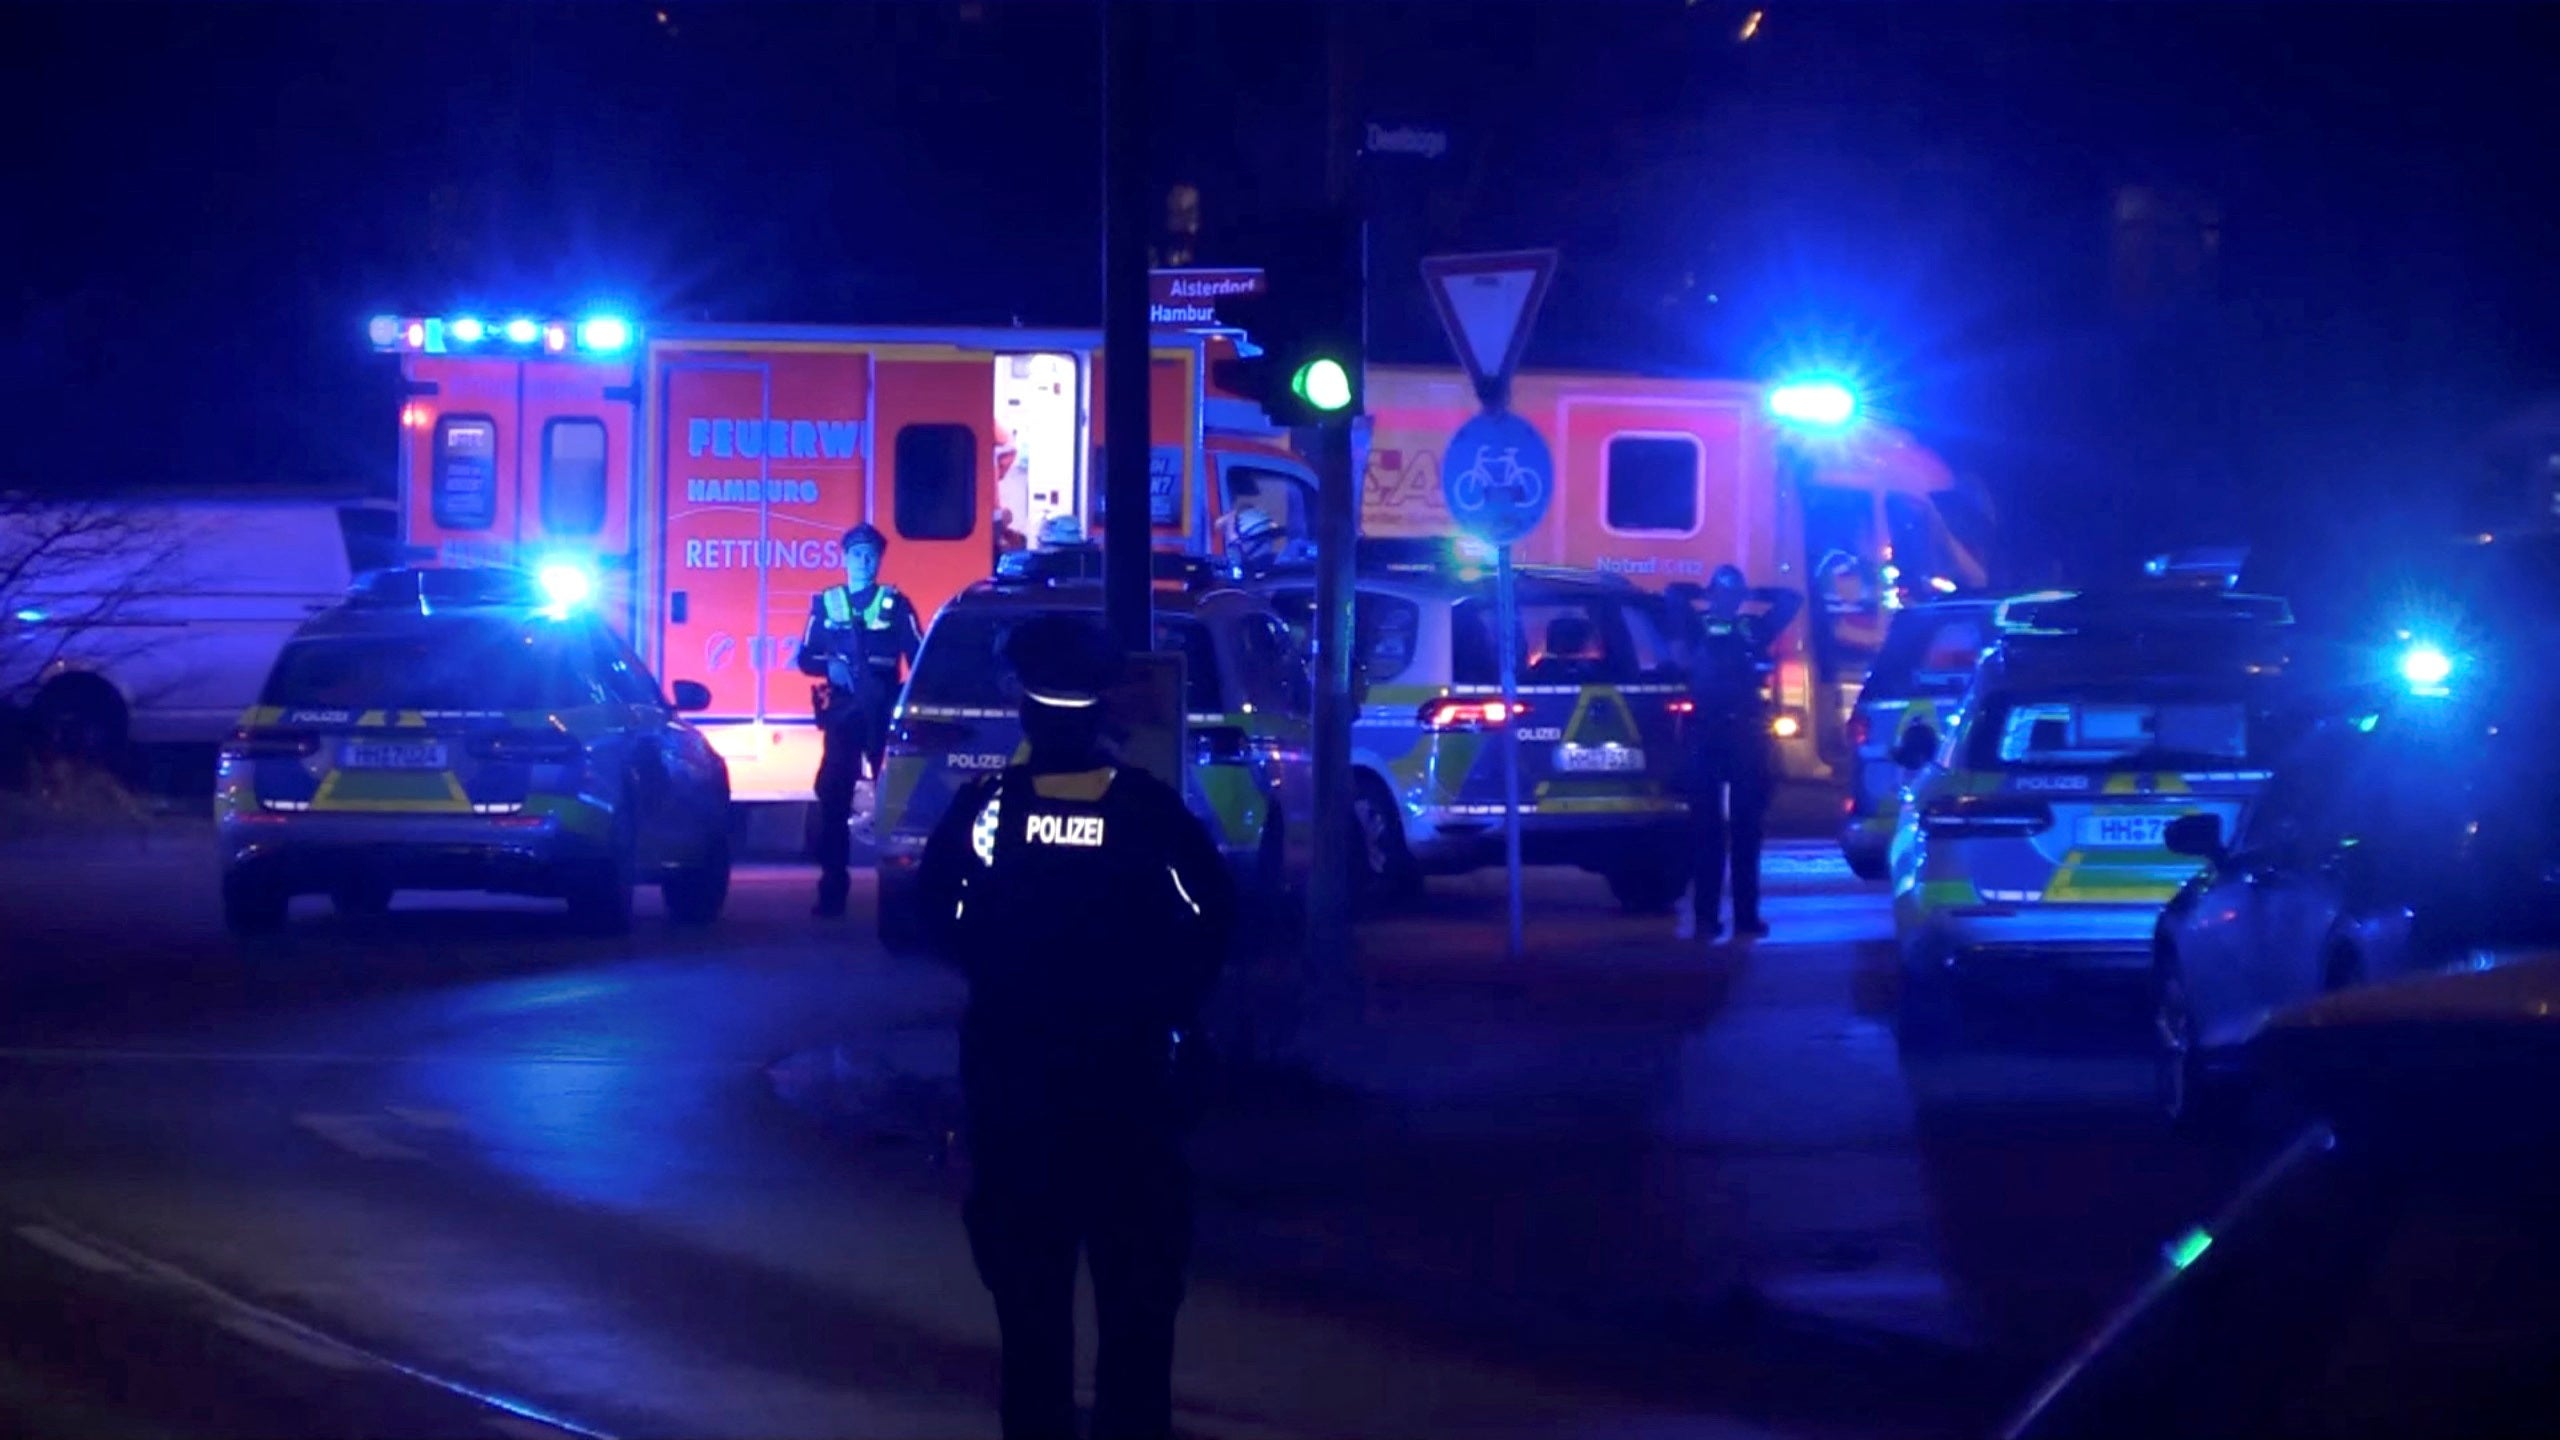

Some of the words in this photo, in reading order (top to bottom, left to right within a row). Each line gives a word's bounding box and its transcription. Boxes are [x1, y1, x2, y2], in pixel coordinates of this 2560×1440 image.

[1150, 303, 1221, 325] Hambur
[687, 478, 819, 503] HAMBURG
[685, 538, 845, 569] RETTUNGS
[292, 709, 349, 723] POLIZEI
[1516, 727, 1562, 741] OLIZEI
[947, 753, 1007, 769] POLIZEI
[2015, 776, 2089, 790] POLIZEI
[1026, 814, 1105, 847] POLIZEI
